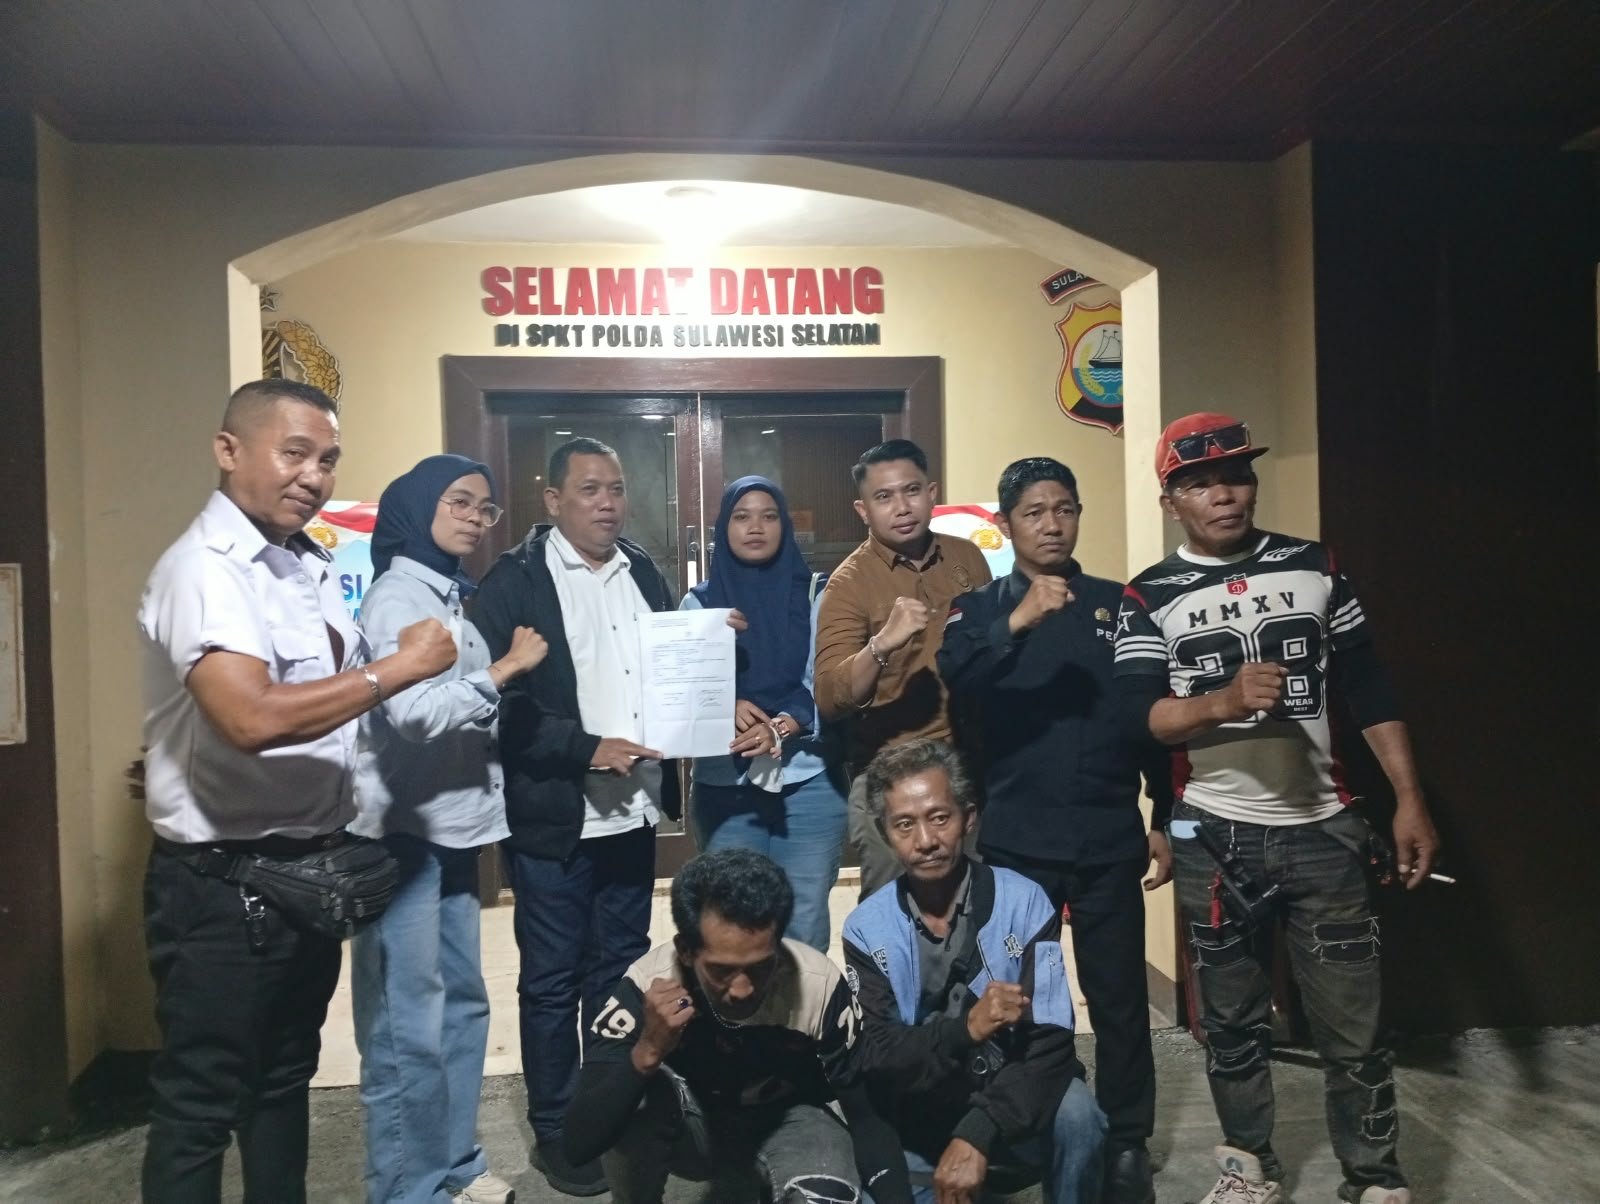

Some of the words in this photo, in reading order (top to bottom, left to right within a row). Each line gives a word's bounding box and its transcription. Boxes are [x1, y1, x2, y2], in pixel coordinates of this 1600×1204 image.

[709, 266, 885, 316] DATANG
[1051, 270, 1087, 290] SULA
[494, 324, 519, 347] DI
[526, 324, 585, 347] SPKT
[592, 324, 663, 347] POLDA
[673, 324, 784, 347] SULAWESI
[791, 323, 881, 346] SELATAN
[1283, 698, 1314, 706] WEAR
[590, 995, 636, 1039] 19
